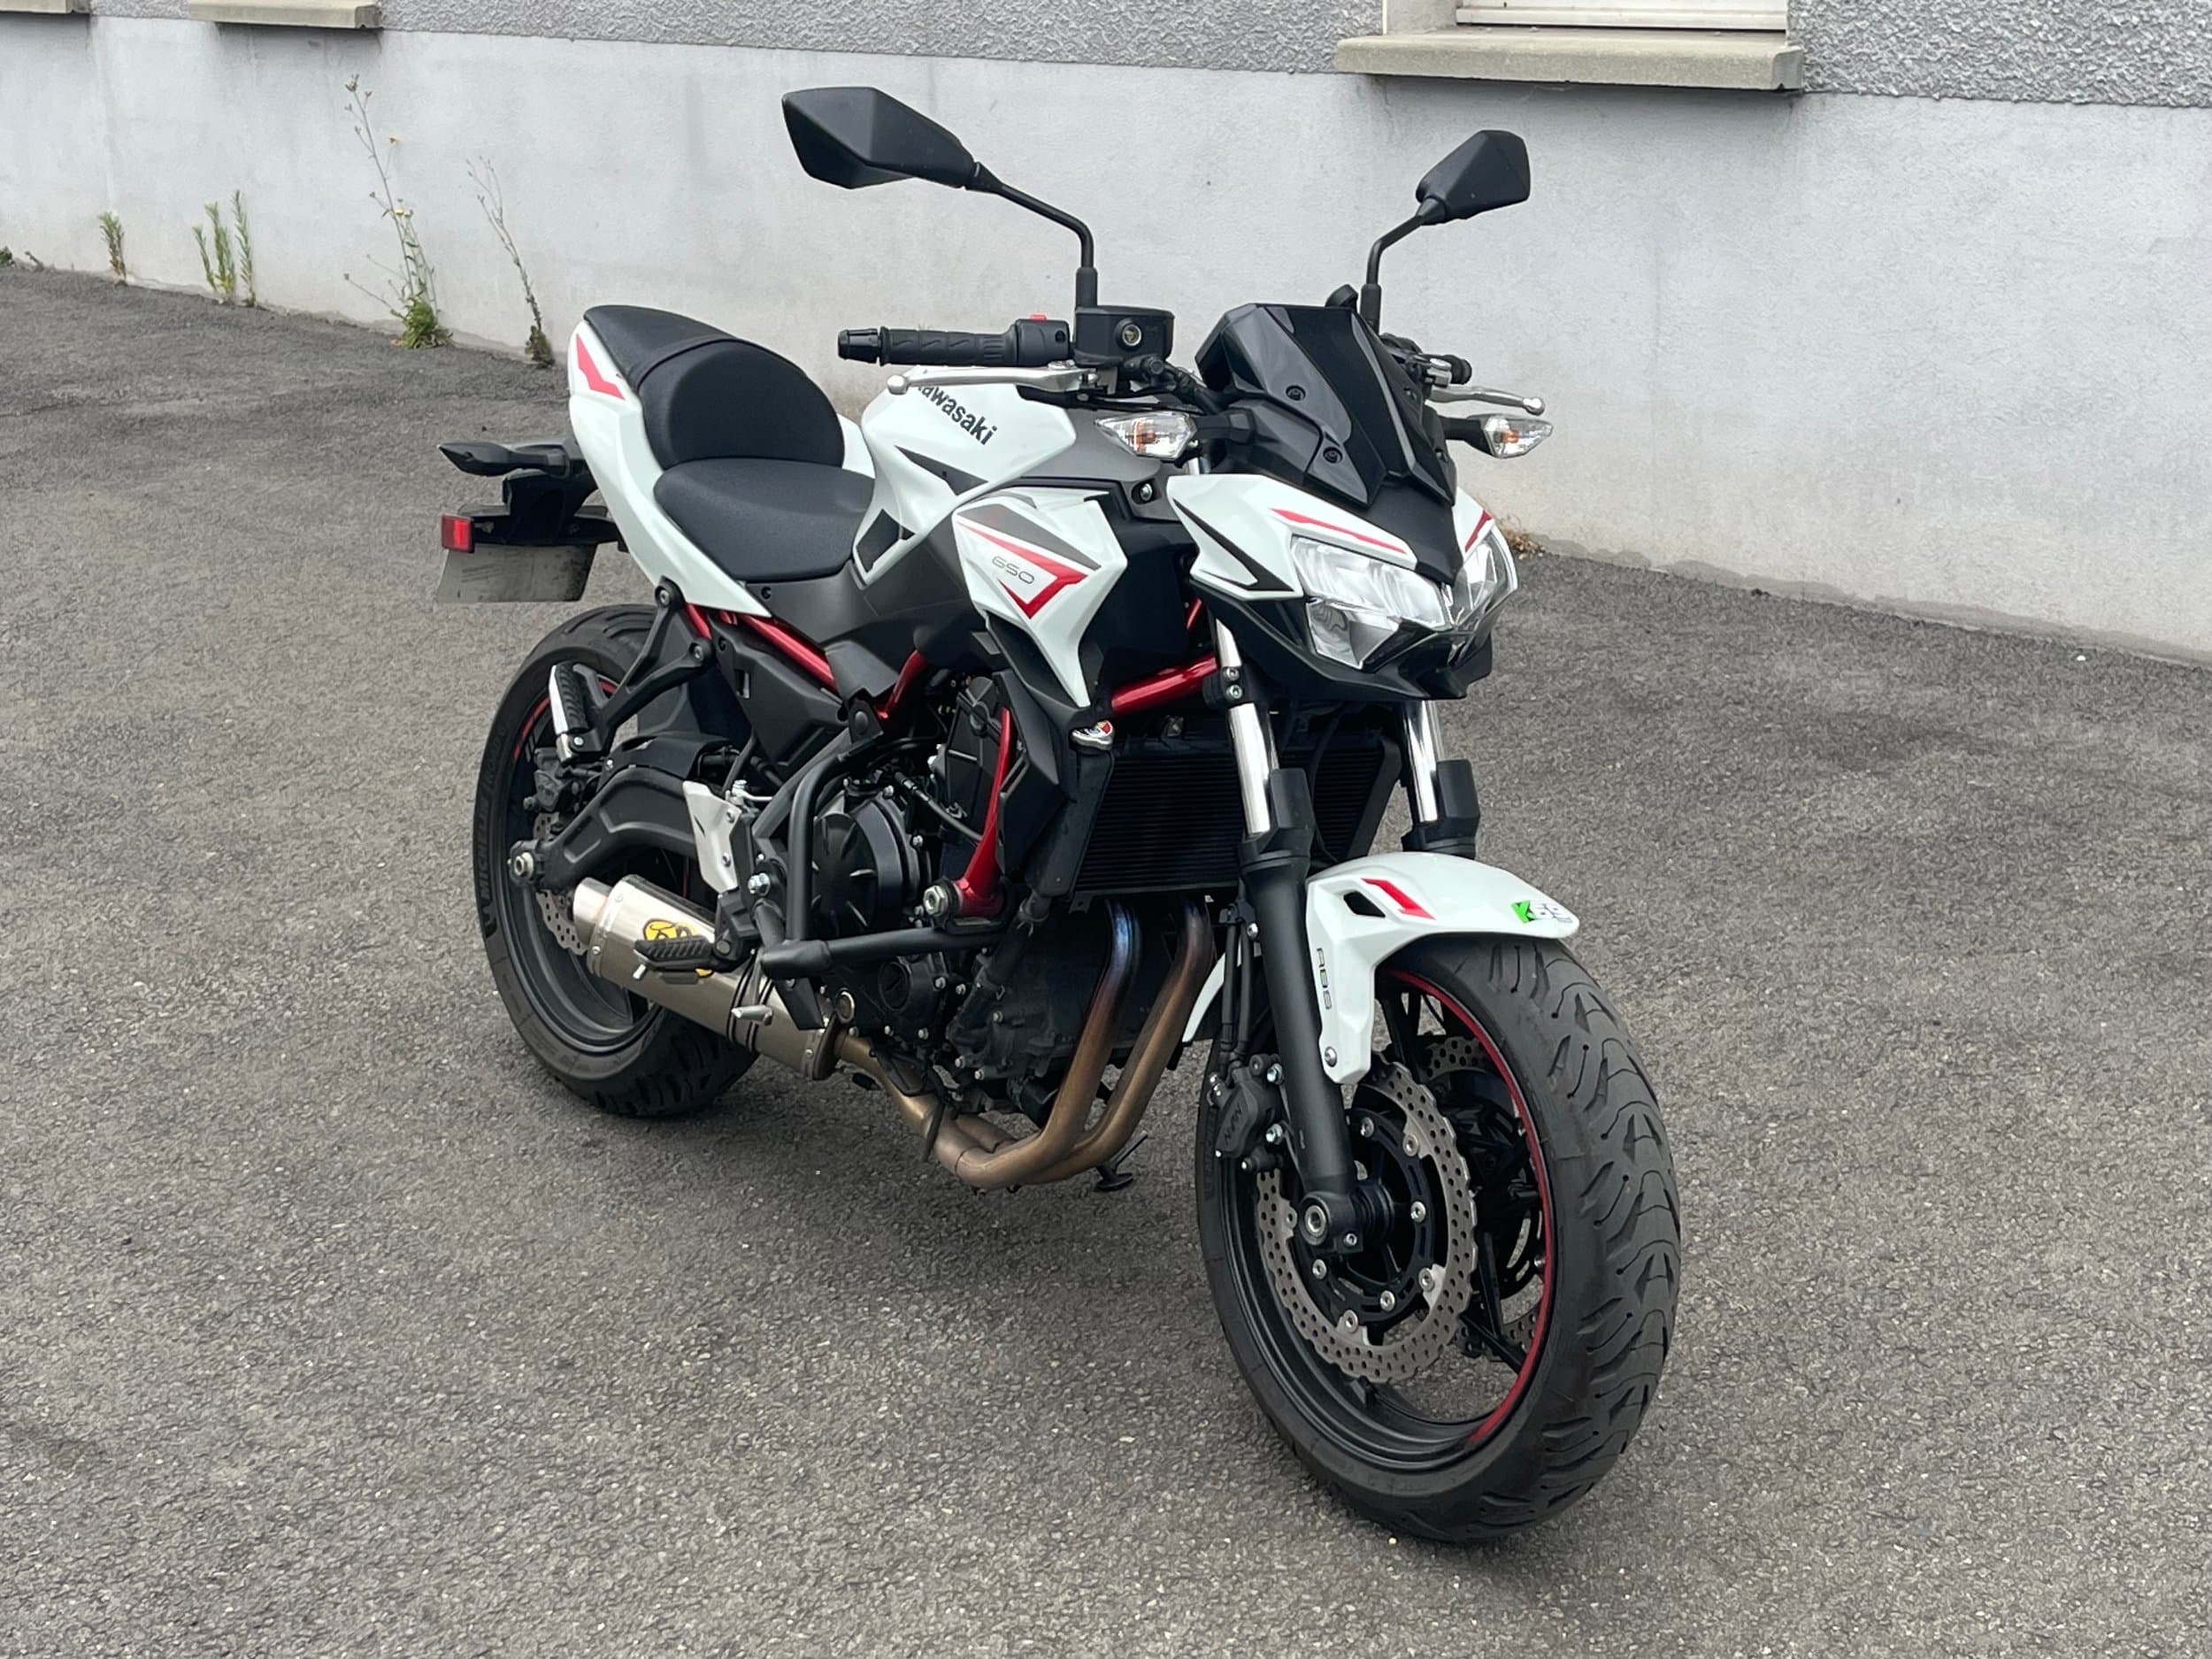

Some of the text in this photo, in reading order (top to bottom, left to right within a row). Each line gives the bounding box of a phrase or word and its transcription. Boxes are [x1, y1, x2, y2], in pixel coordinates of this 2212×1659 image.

[918, 386, 998, 445] awasaki
[992, 556, 1035, 584] 650
[1317, 948, 1333, 1010] ABS
